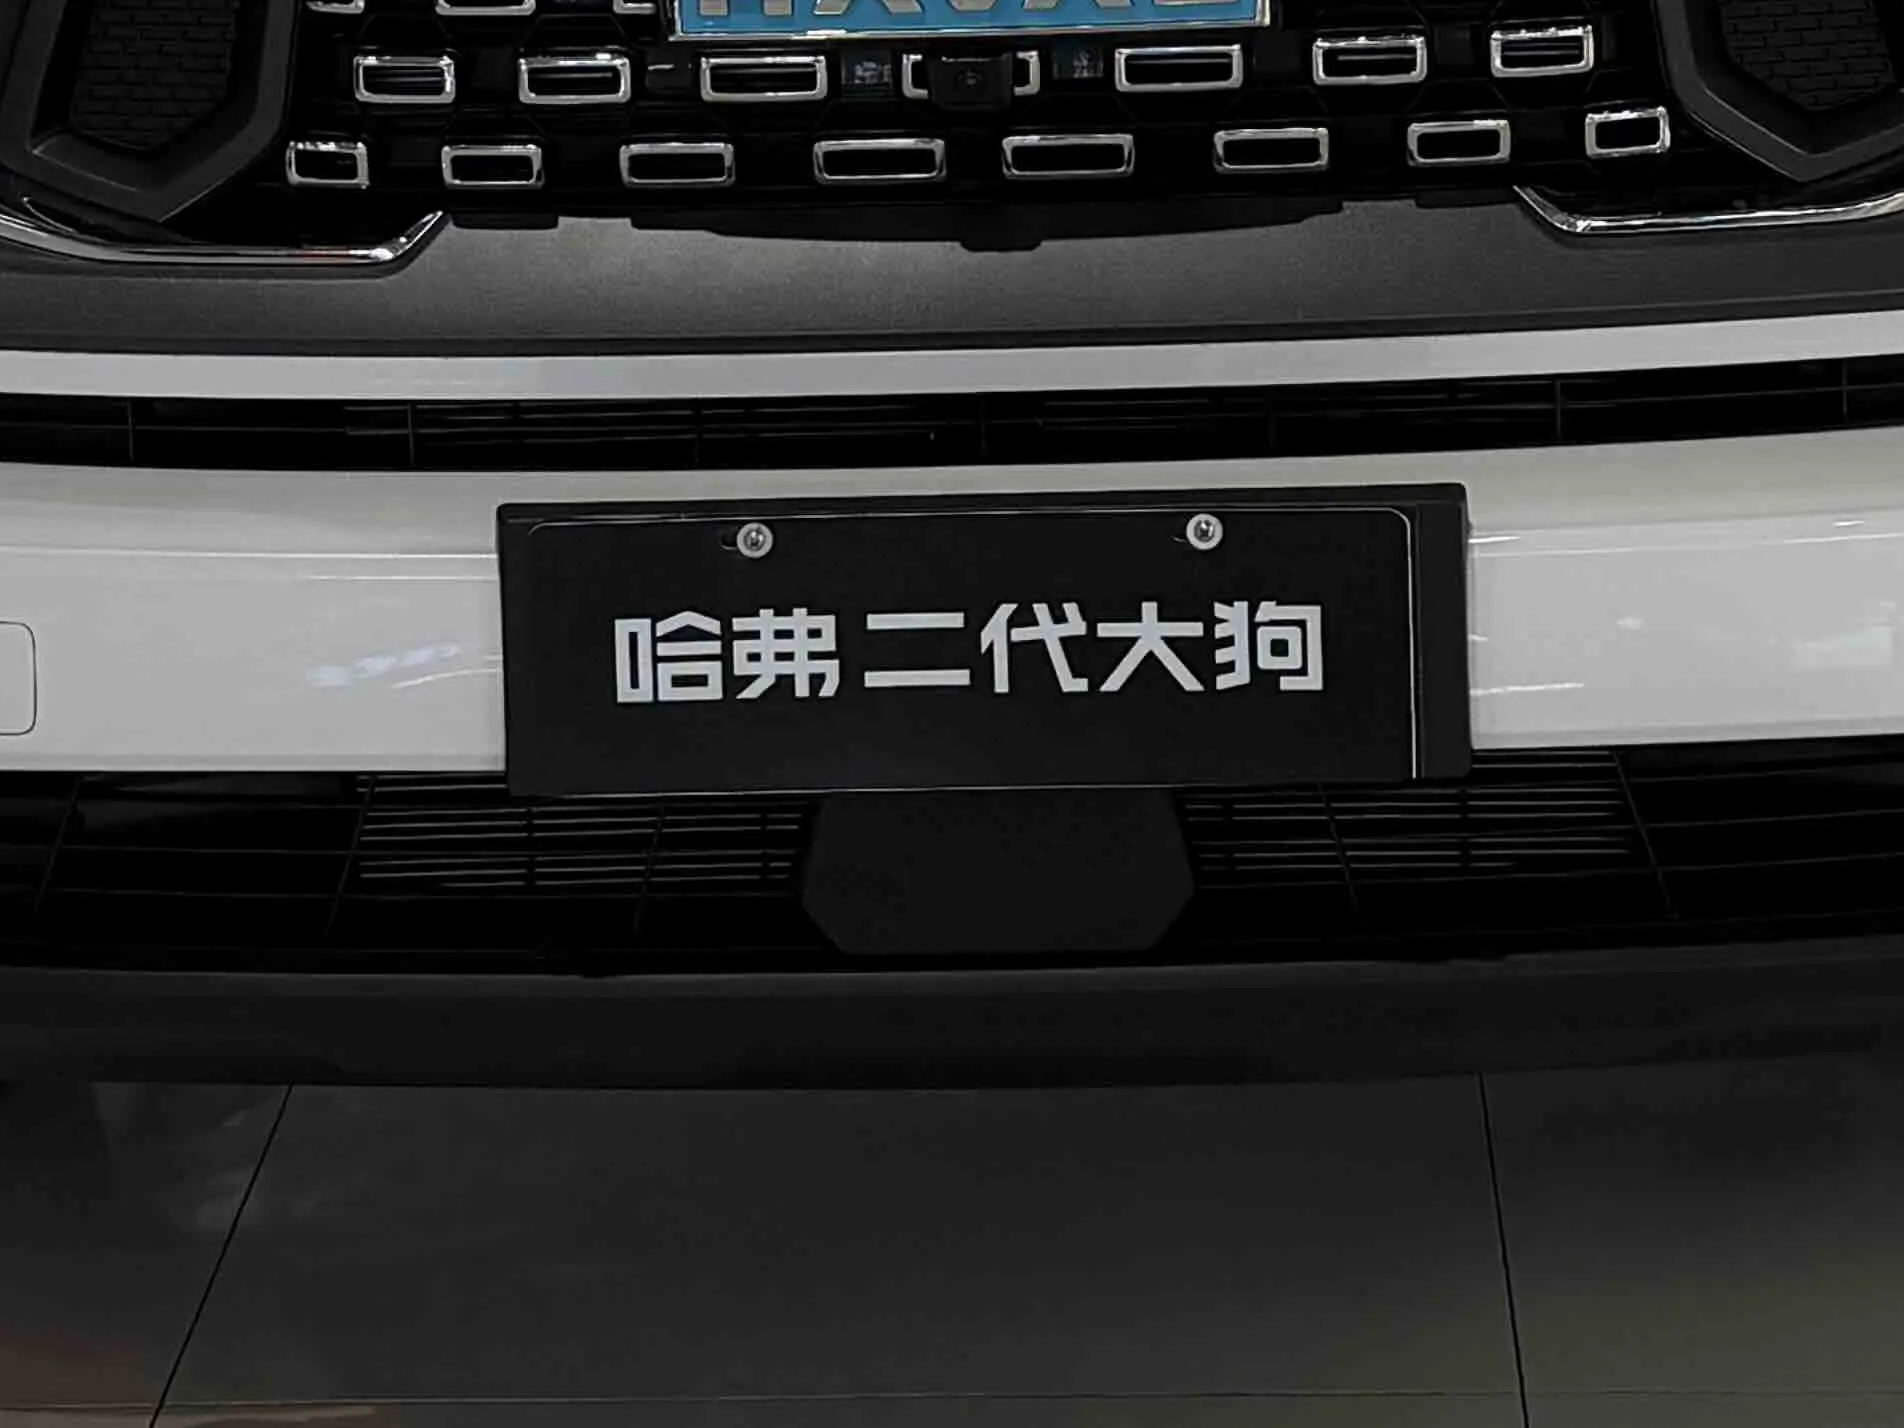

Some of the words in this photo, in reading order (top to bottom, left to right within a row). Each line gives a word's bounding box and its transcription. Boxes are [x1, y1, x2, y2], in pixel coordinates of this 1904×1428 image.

[613, 599, 1326, 704] 哈弗二代大狗
